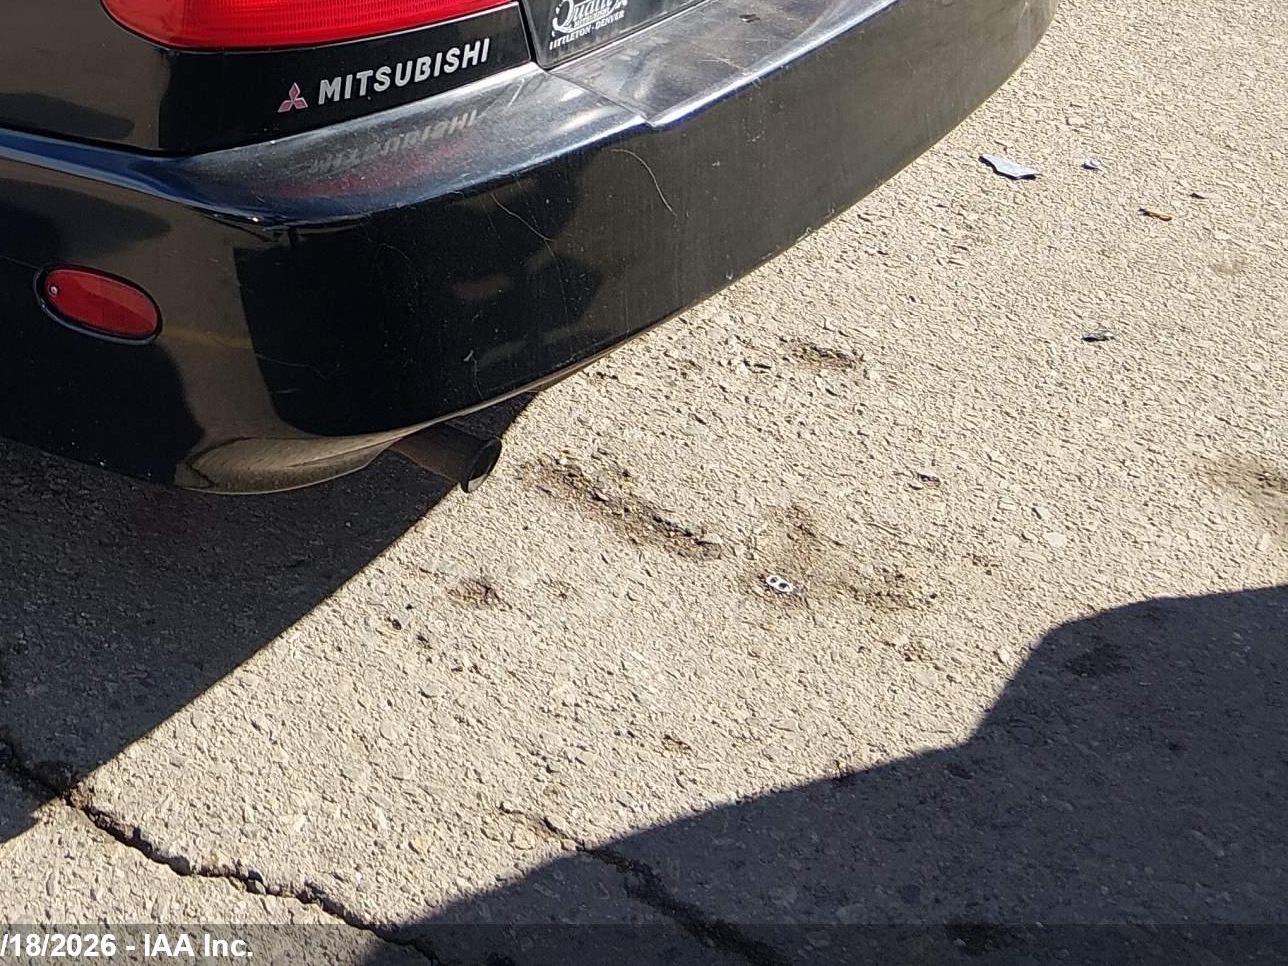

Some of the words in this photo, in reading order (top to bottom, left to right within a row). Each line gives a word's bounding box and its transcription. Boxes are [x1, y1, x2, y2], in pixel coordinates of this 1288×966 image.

[549, 25, 592, 50] LITTLETON
[595, 9, 625, 30] DENVER
[317, 37, 491, 105] MITSUBISHI
